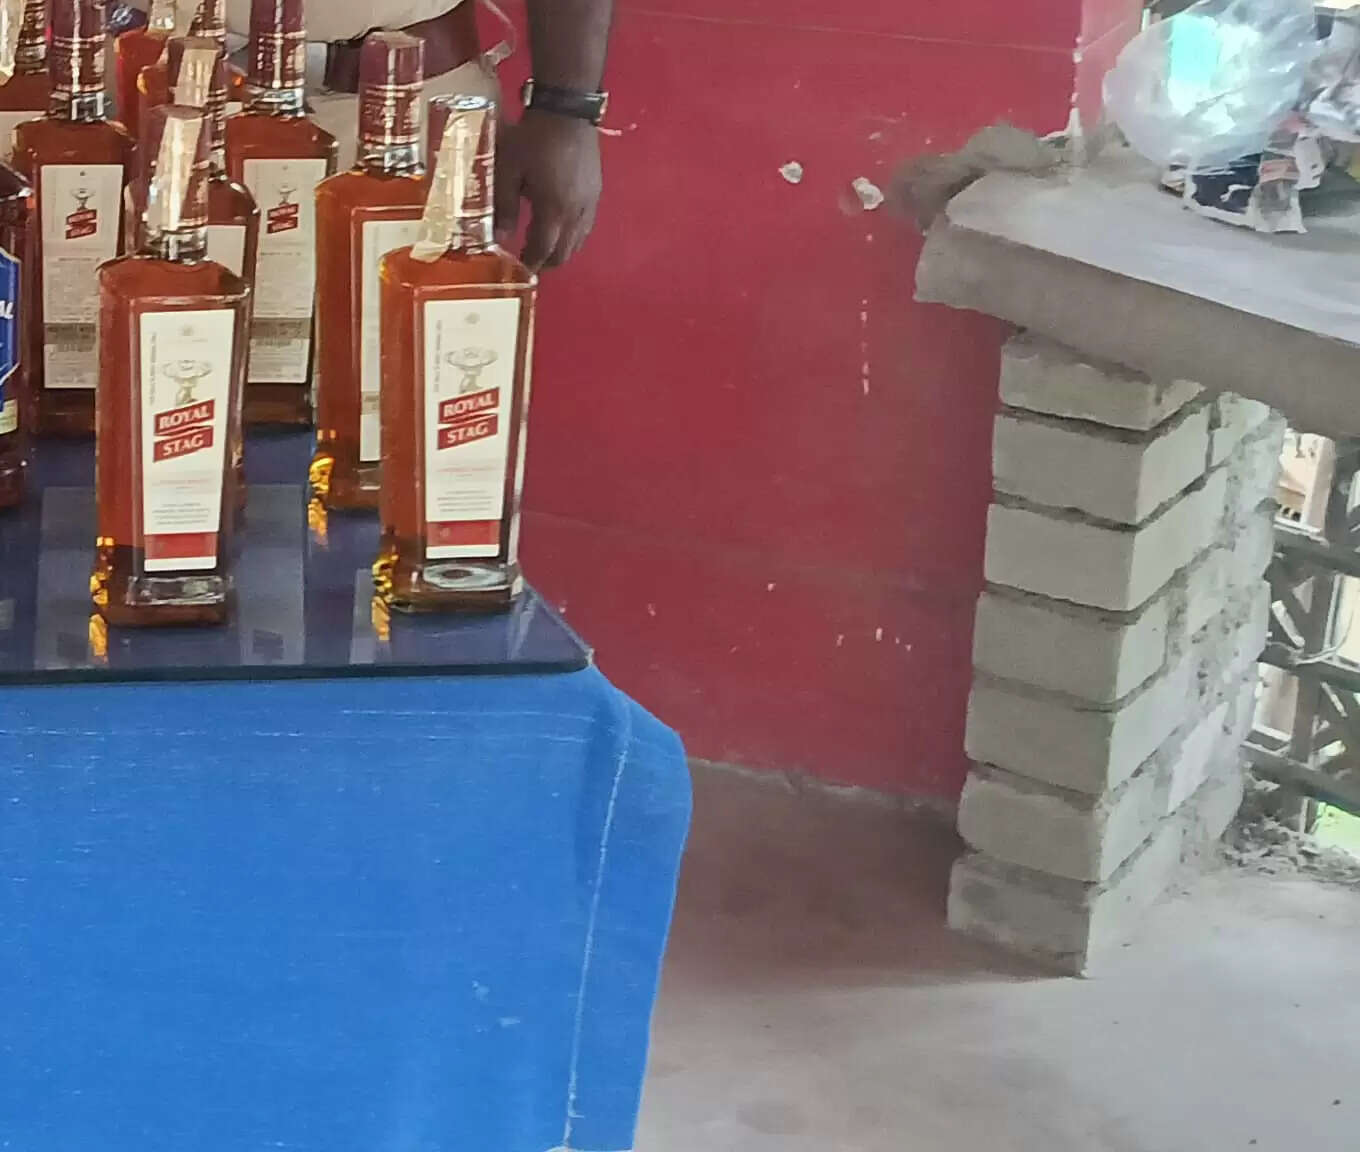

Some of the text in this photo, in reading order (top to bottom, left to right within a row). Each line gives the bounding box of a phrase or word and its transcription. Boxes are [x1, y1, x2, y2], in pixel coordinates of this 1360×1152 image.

[158, 403, 210, 431] ROYAL
[443, 392, 495, 418] ROYAL
[162, 433, 205, 456] STAG
[447, 421, 489, 444] STAG
